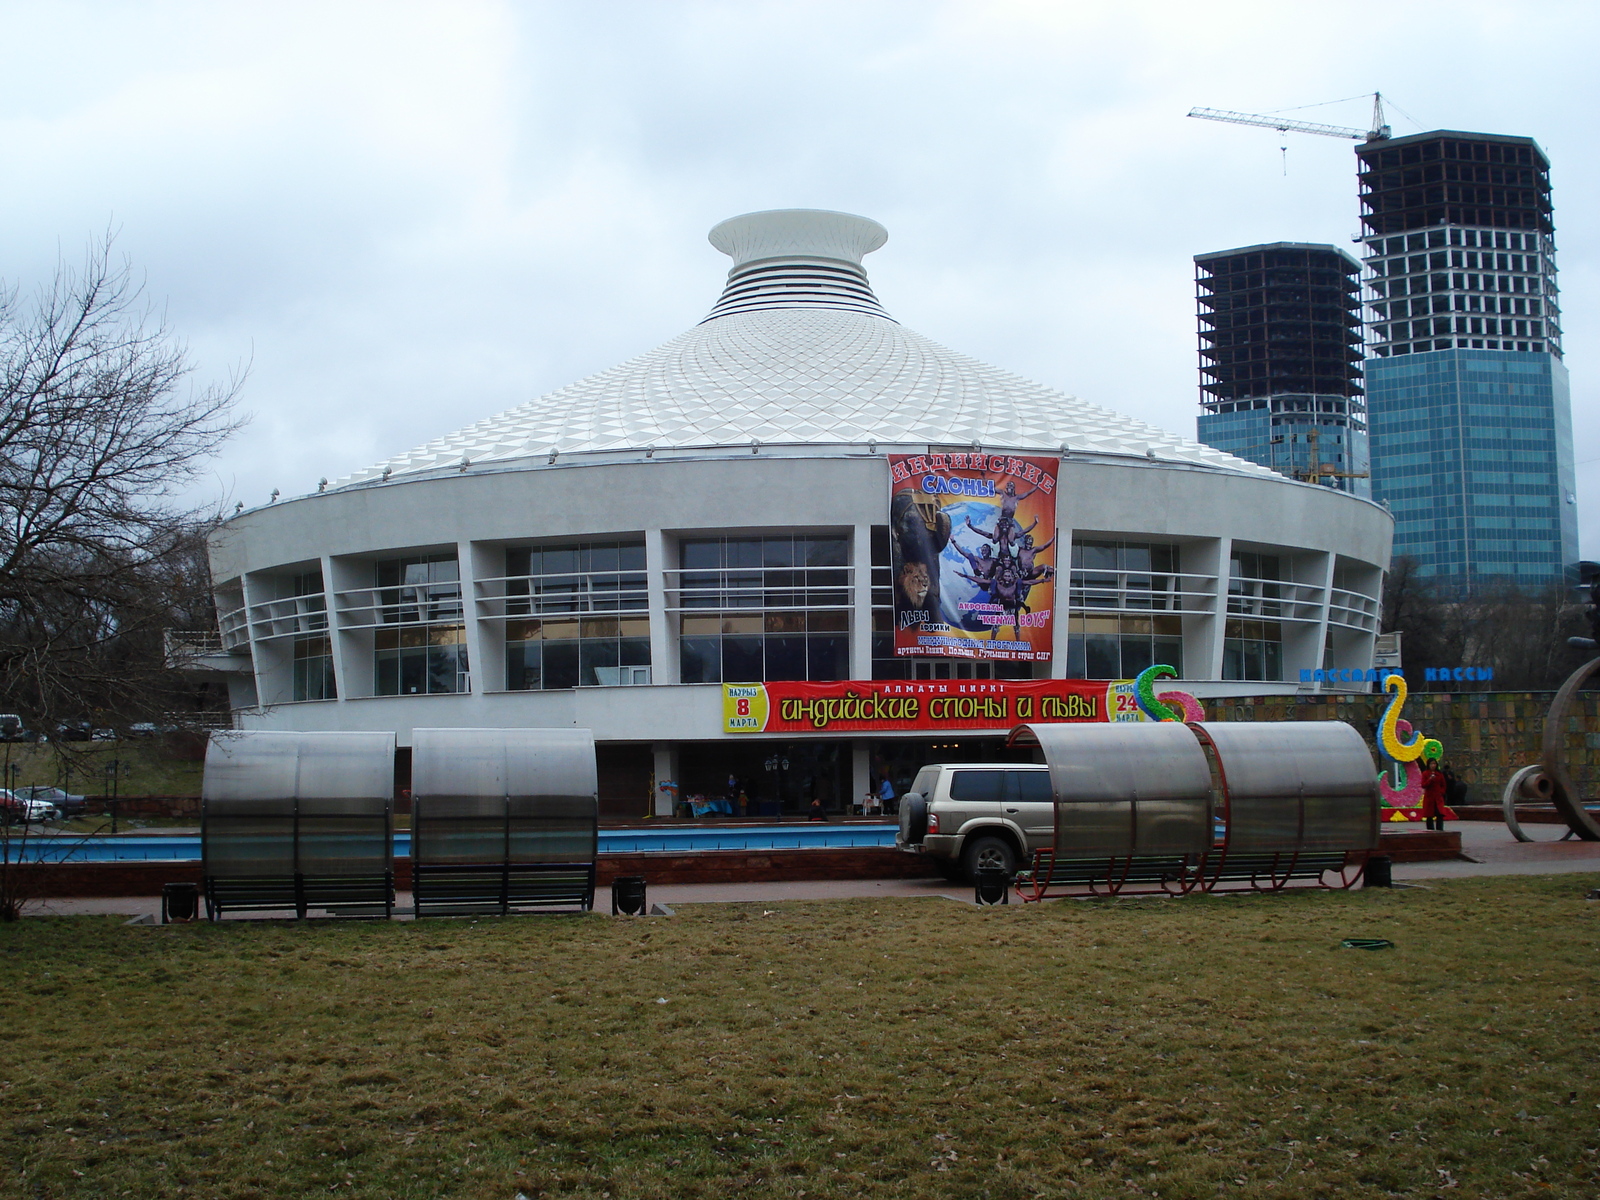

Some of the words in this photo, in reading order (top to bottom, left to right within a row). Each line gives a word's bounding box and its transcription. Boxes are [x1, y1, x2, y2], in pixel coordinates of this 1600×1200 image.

[922, 475, 995, 497] СЛОНЫ
[958, 602, 1004, 612] АКРОБАТЫ
[900, 610, 929, 631] ЛЬВЫ
[920, 623, 951, 632] АФРИКИ
[1425, 666, 1494, 682] КАССЫ
[729, 687, 757, 697] НАУРЫЗ
[884, 685, 947, 693] АЛМАТЫ
[736, 698, 750, 716] 8
[1116, 694, 1138, 712] 24
[729, 718, 758, 727] МАРТА
[1115, 713, 1140, 722] МАРТА
